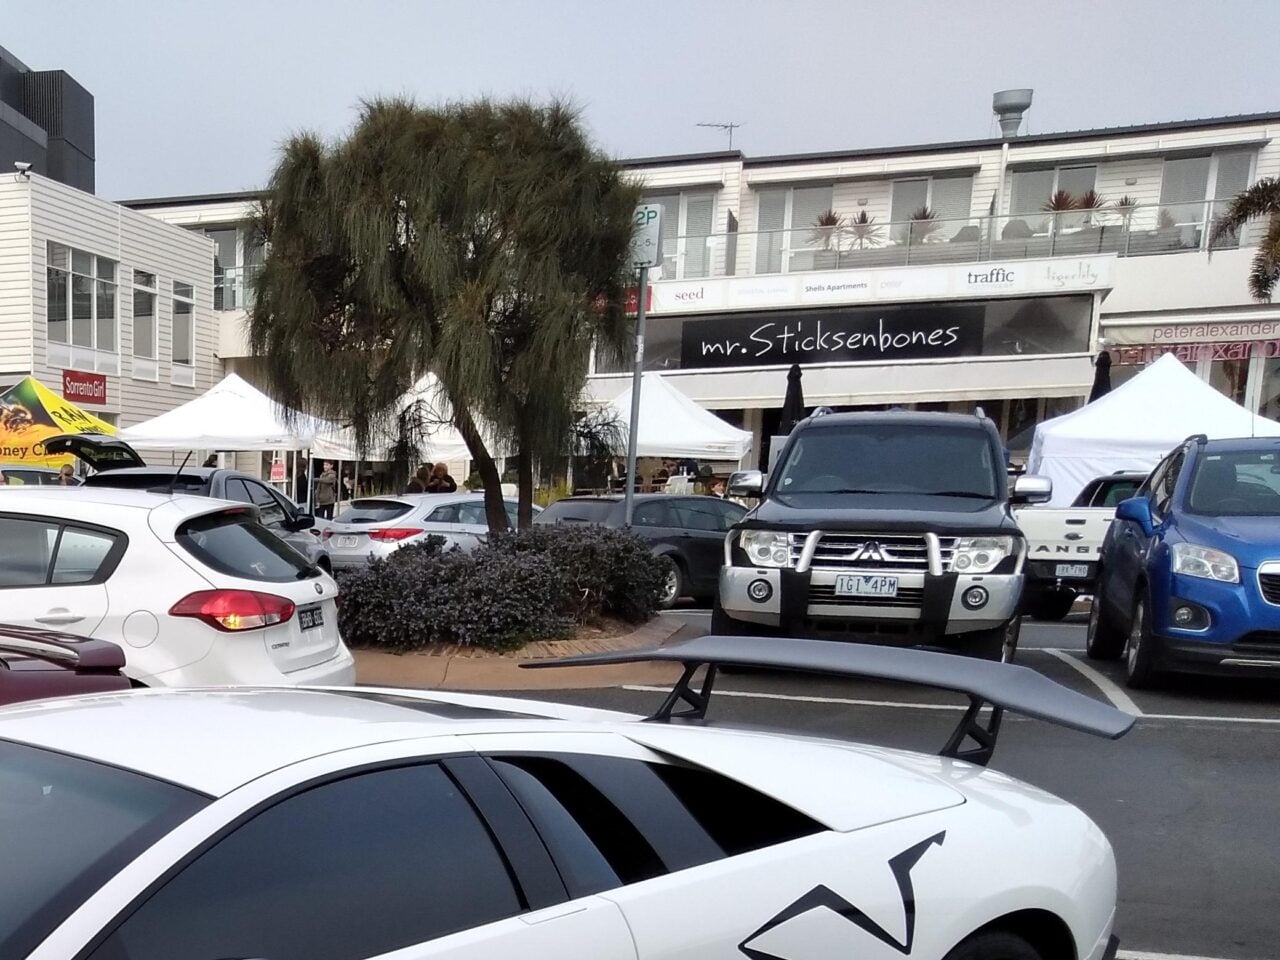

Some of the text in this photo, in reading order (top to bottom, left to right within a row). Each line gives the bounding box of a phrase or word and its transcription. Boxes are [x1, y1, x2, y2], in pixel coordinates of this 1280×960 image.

[636, 210, 657, 225] 2P
[967, 267, 1015, 285] traffic
[805, 282, 868, 292] Shells Apartments
[674, 288, 704, 301] seed
[1153, 320, 1279, 341] peteralexander
[65, 376, 105, 397] Sorrento Girl
[1028, 545, 1102, 553] ANG
[872, 579, 896, 592] 4PM
